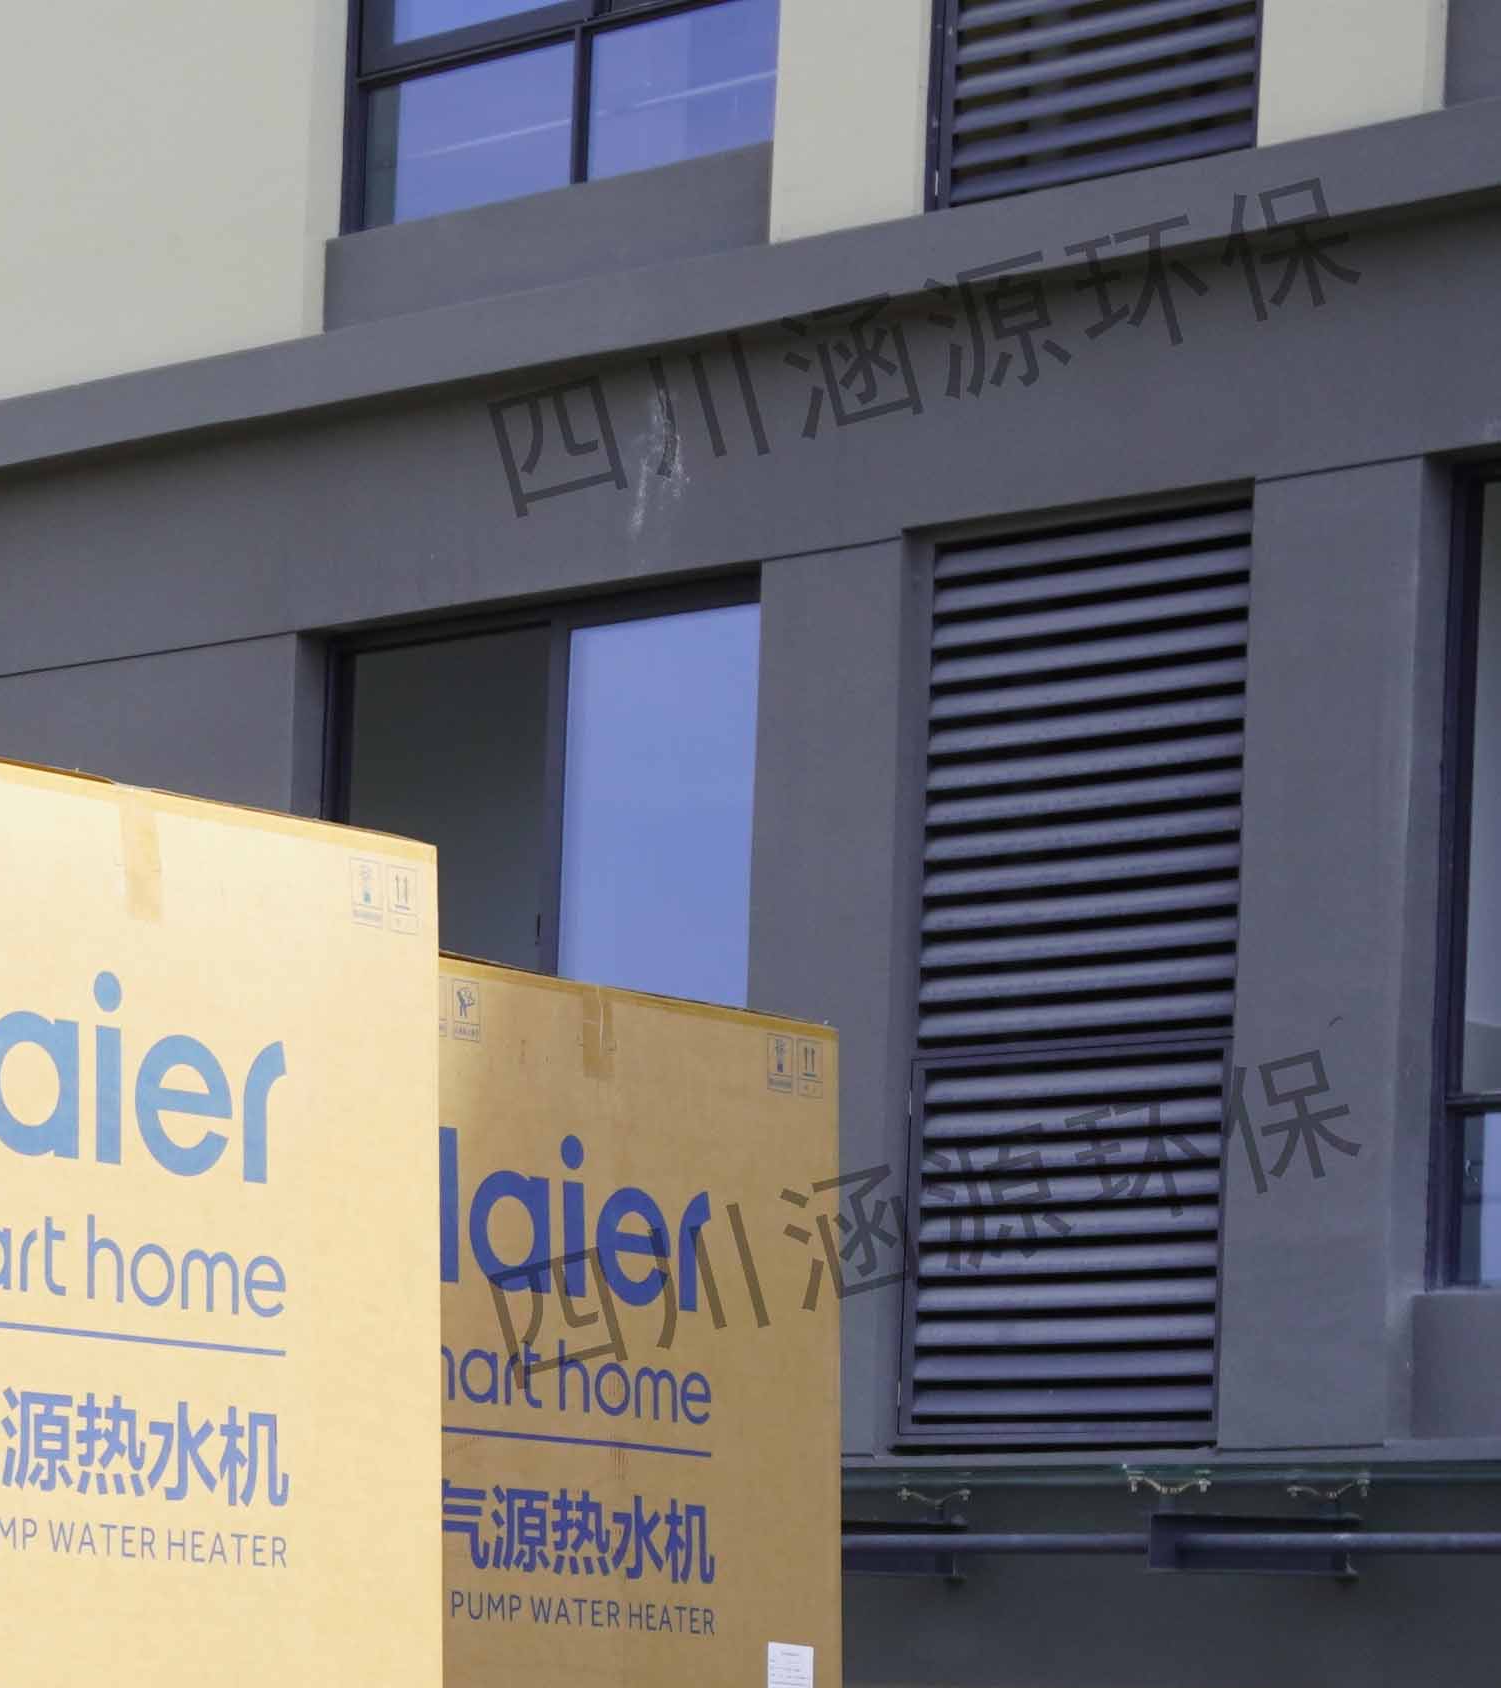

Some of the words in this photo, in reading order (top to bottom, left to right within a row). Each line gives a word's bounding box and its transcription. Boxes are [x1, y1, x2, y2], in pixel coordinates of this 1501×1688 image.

[87, 1214, 287, 1318] home
[441, 1342, 542, 1410] art
[559, 1339, 711, 1425] home
[49, 1520, 155, 1560] WATER
[168, 1529, 287, 1568] HEATER
[441, 1478, 715, 1585] 气源热水机
[451, 1591, 522, 1622] PUMP
[530, 1595, 619, 1628] WATER
[628, 1604, 715, 1635] HEATER
